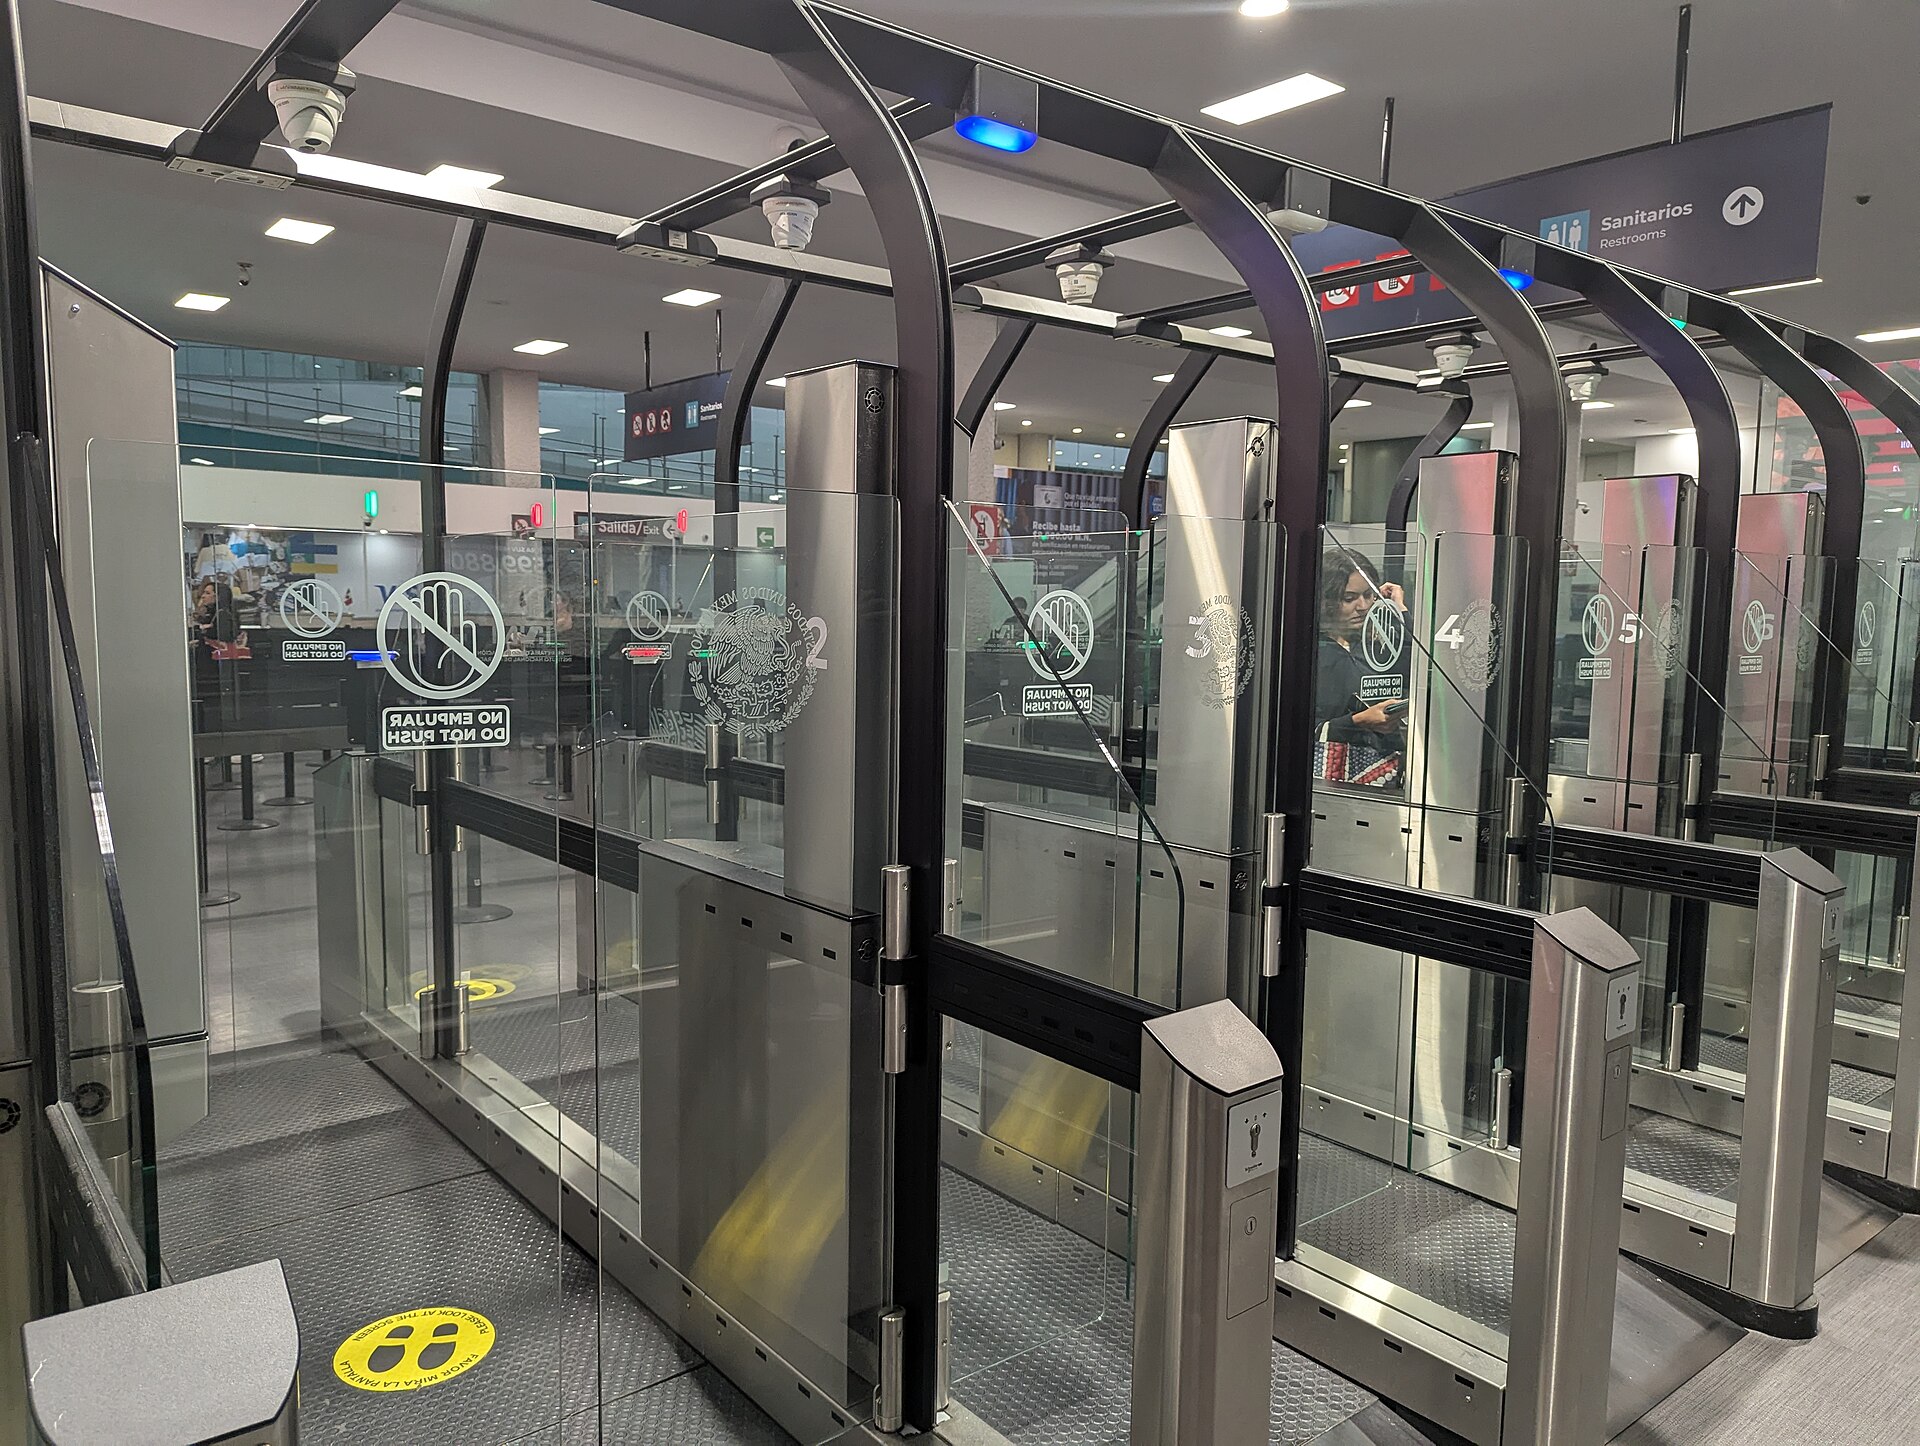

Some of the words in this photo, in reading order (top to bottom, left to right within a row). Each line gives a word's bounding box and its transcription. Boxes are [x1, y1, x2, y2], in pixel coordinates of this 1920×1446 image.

[1600, 202, 1693, 231] Sanitarios
[1599, 229, 1667, 249] Restrooms
[700, 402, 723, 413] Sanitarios
[1032, 521, 1059, 531] Recibe
[1060, 522, 1081, 532] hasta
[1184, 615, 1212, 659] 3
[1434, 614, 1465, 650] 4
[1618, 613, 1644, 644] 5
[806, 617, 828, 670] 2
[395, 1312, 420, 1321] THE
[436, 1309, 465, 1319] LOOK
[465, 1314, 490, 1335] PLEASE
[352, 1318, 394, 1342] SCREEN
[339, 1359, 381, 1388] PANTALLA
[441, 1353, 479, 1378] FAVOR
[383, 1380, 400, 1388] LA
[404, 1373, 439, 1388] MIRA
